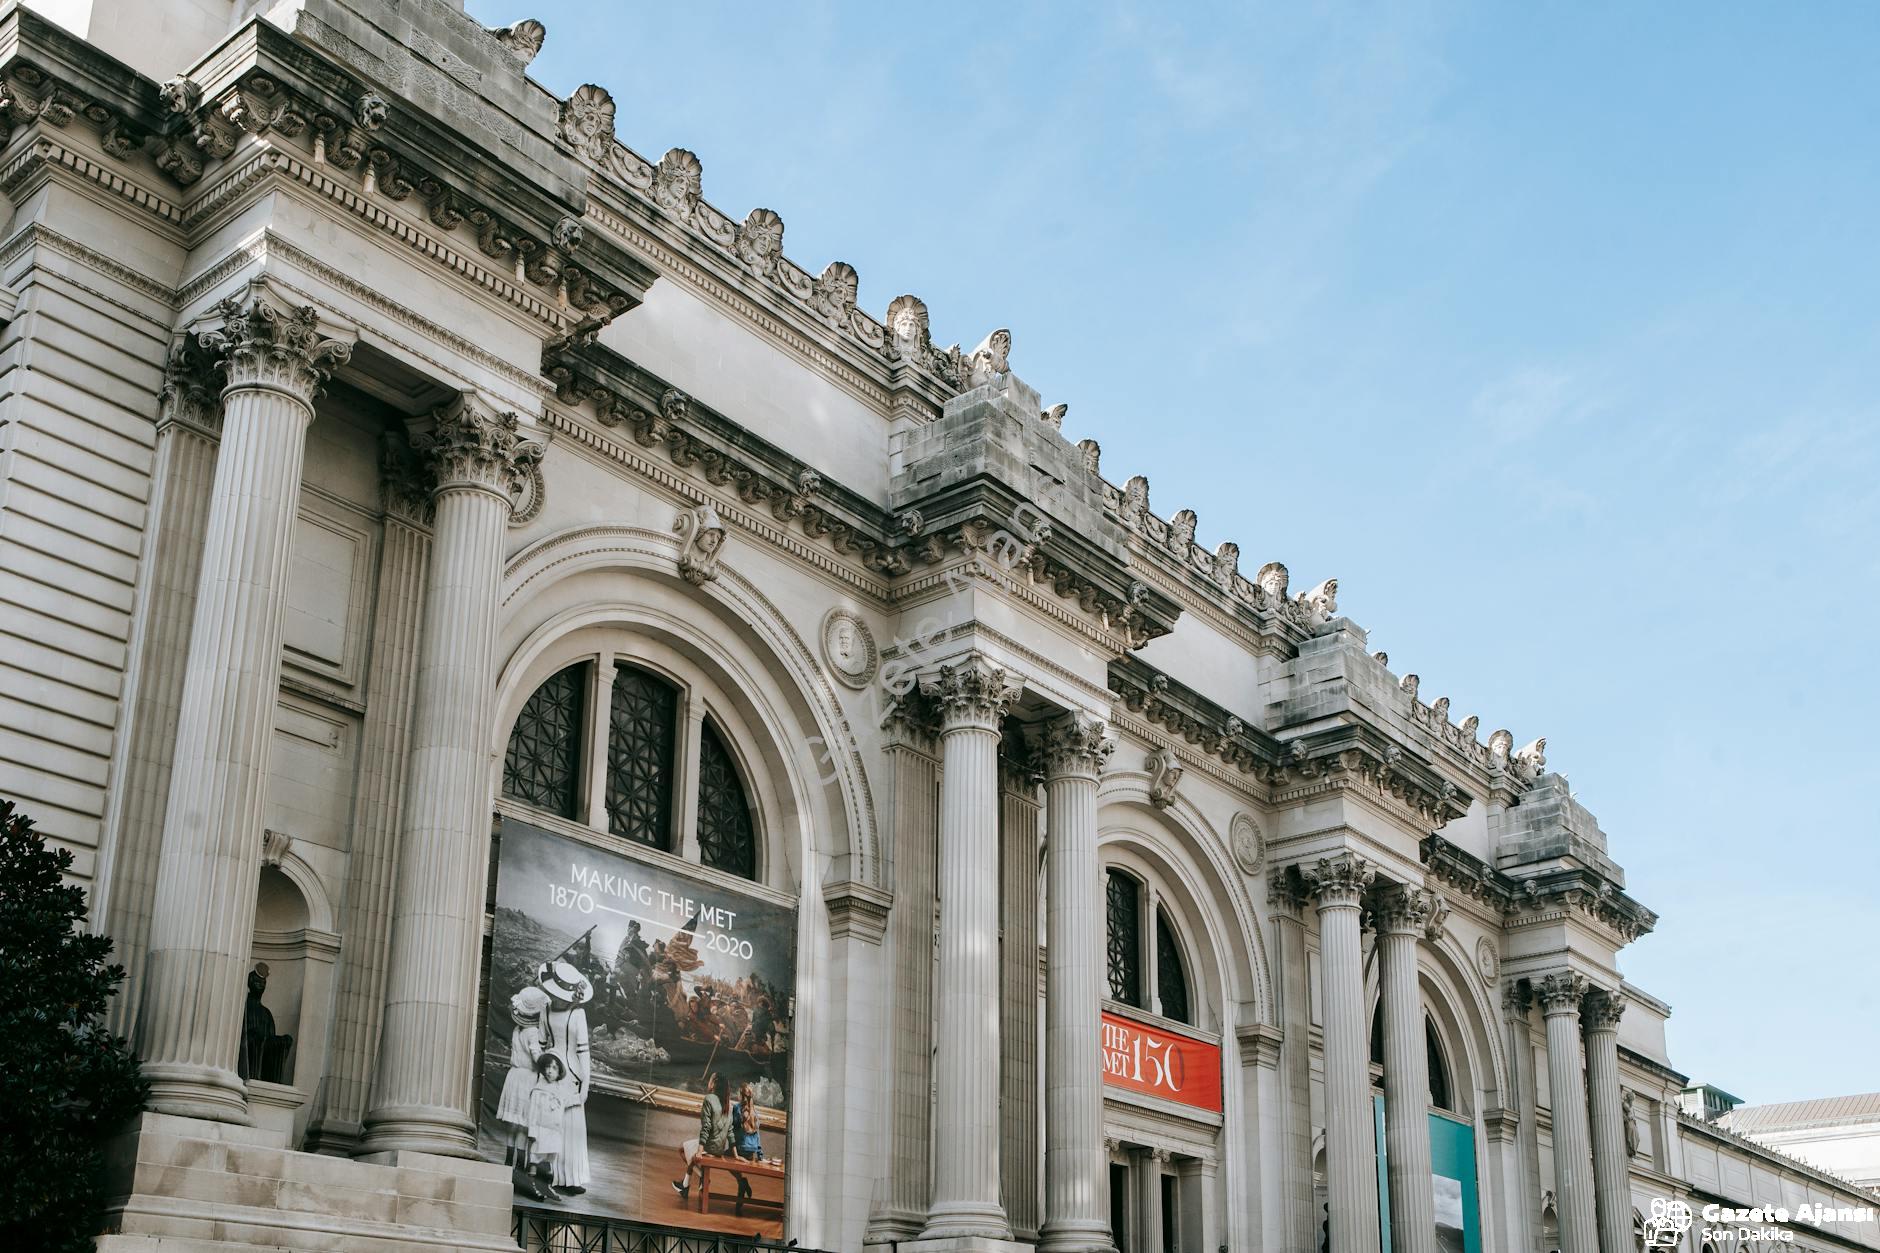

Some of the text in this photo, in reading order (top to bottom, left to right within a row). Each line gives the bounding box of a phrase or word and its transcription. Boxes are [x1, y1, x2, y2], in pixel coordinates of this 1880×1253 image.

[549, 884, 753, 960] 1870 2020
[571, 864, 737, 931] MAKING THE MET
[1102, 1022, 1130, 1053] THE
[1102, 1048, 1130, 1079] MET
[1131, 1033, 1185, 1092] 150
